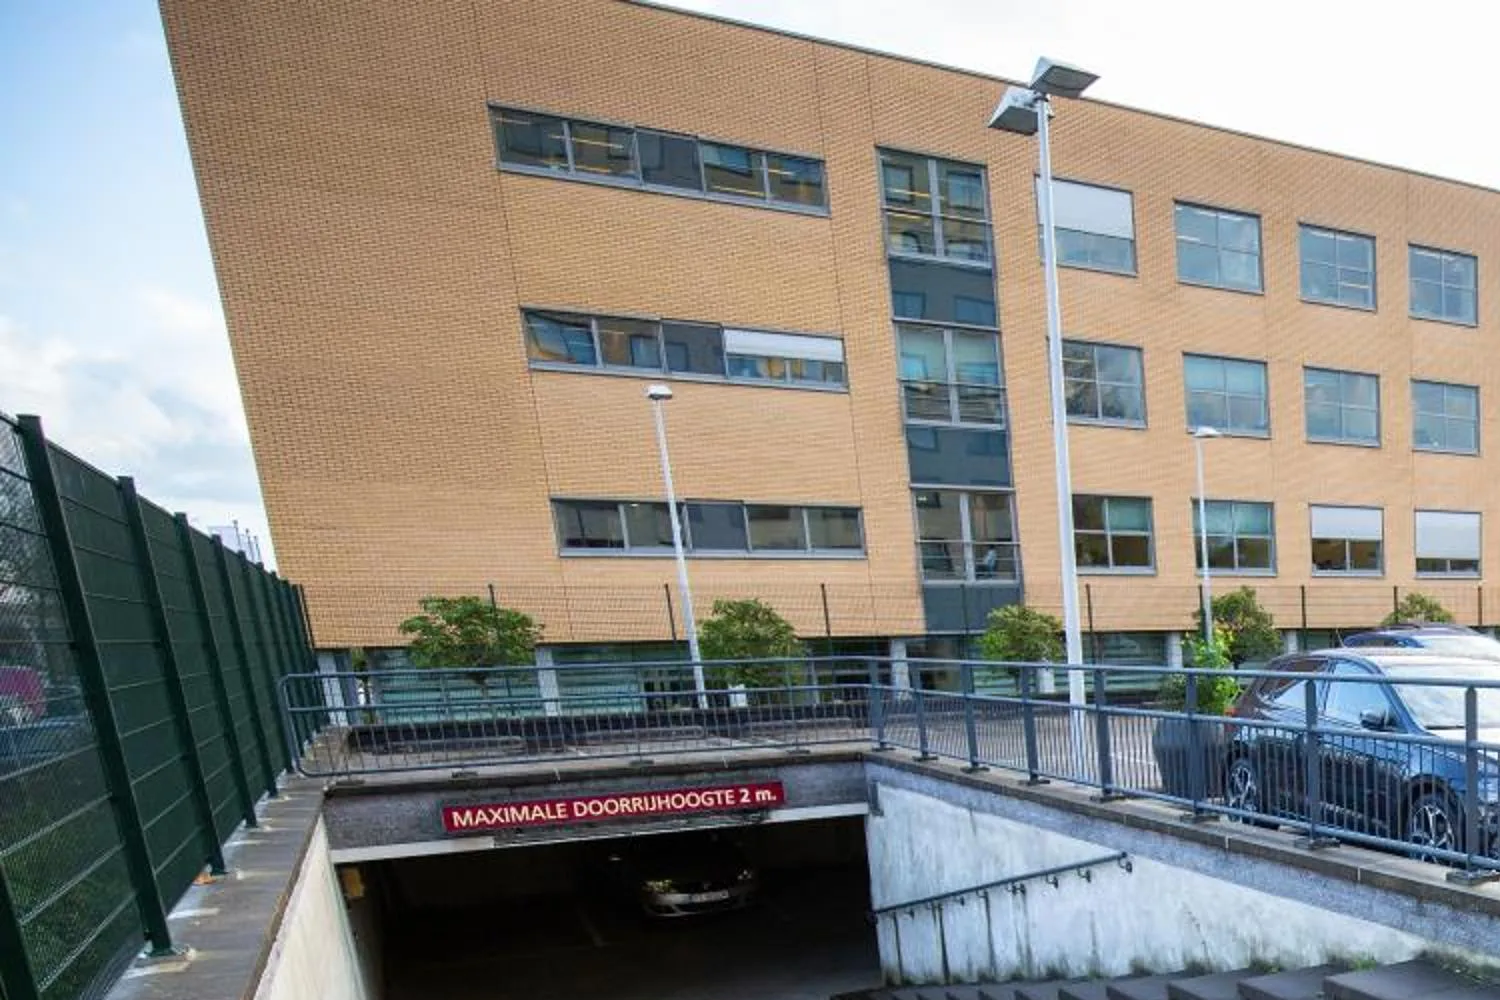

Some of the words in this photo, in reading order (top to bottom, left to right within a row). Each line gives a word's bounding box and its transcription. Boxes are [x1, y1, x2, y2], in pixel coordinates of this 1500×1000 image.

[452, 803, 568, 828] MAXIMALE
[573, 790, 735, 817] DOORRIJHOOGTE
[738, 788, 752, 803] 2
[755, 788, 778, 803] m.
